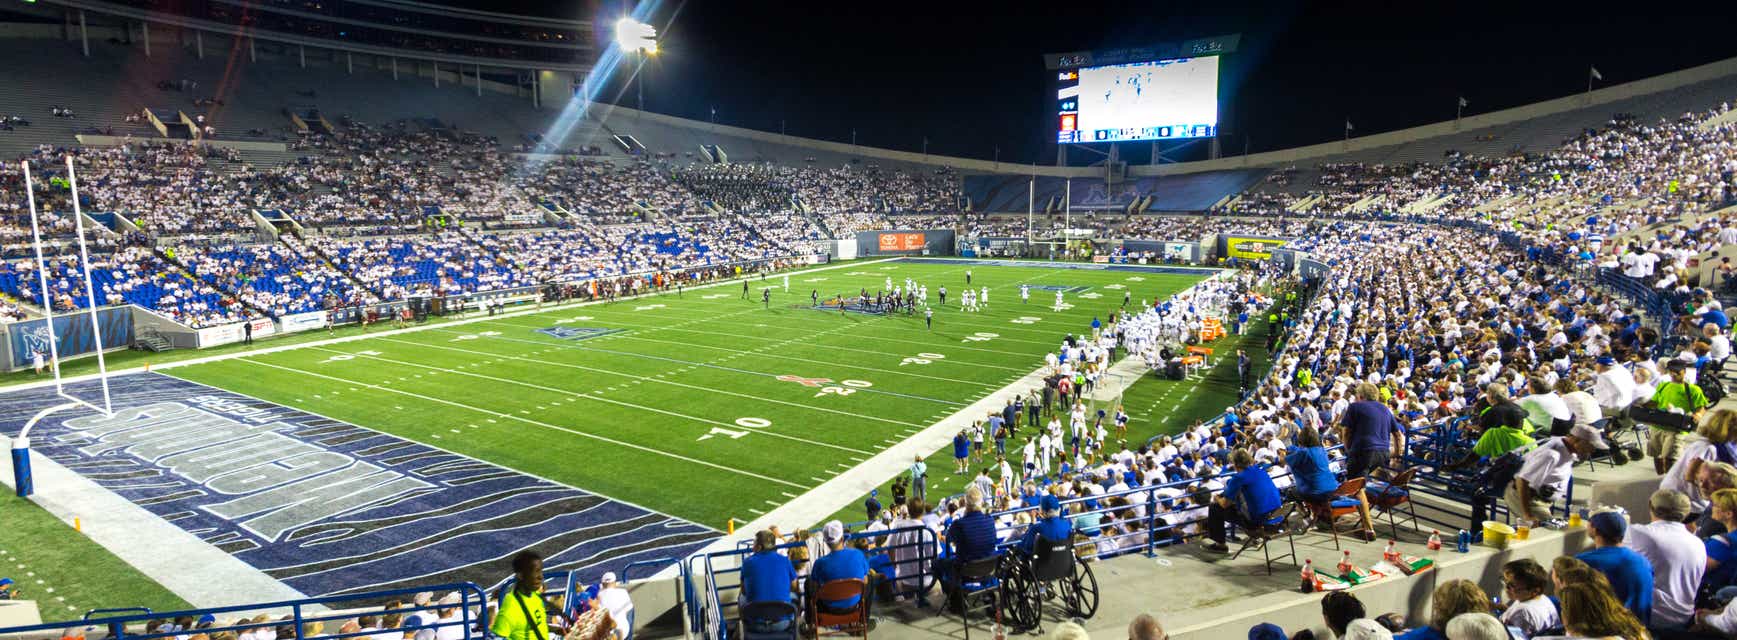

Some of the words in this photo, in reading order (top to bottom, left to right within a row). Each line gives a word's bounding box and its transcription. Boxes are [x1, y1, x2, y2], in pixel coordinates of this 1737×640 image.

[1059, 72, 1078, 81] FedEx
[251, 320, 273, 331] ESPN
[821, 379, 873, 396] 20
[187, 395, 283, 423] TIGERS
[709, 417, 772, 440] 10
